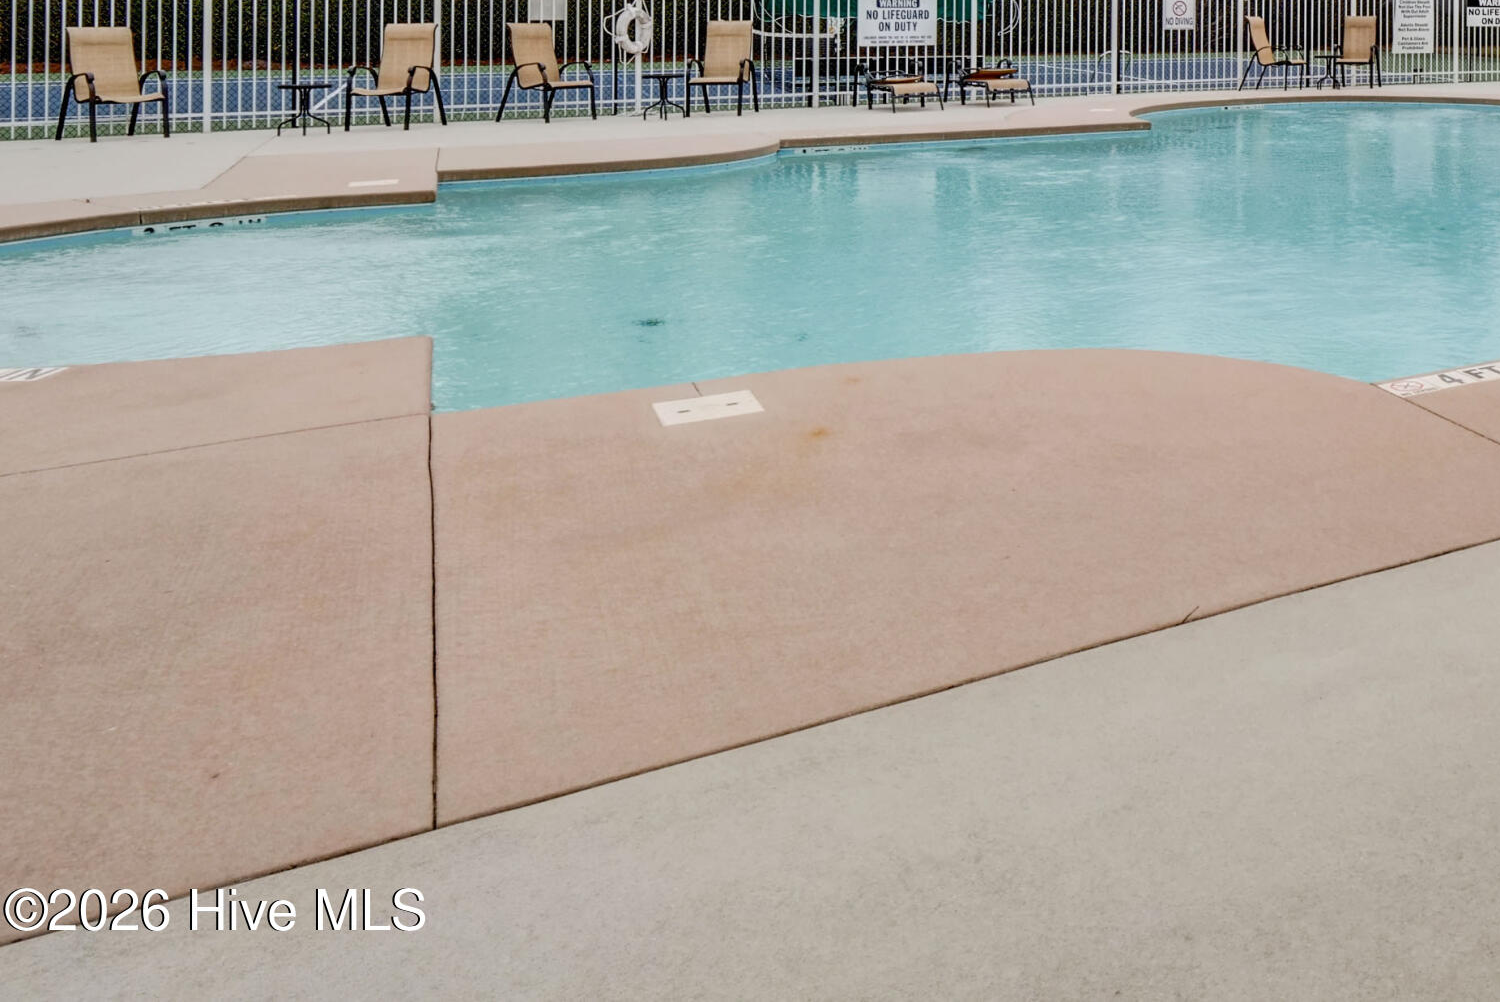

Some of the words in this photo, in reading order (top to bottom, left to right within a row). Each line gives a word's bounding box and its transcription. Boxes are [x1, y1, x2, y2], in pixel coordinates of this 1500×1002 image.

[878, 0, 918, 8] WARNING
[866, 10, 879, 20] NO
[882, 9, 930, 20] LIFEGUARD
[1468, 8, 1481, 16] NO
[1165, 17, 1174, 26] NO
[1174, 17, 1194, 26] DIVING
[1481, 17, 1494, 25] ON
[878, 21, 891, 32] ON
[894, 21, 918, 32] DUTY
[1437, 373, 1465, 385] 4
